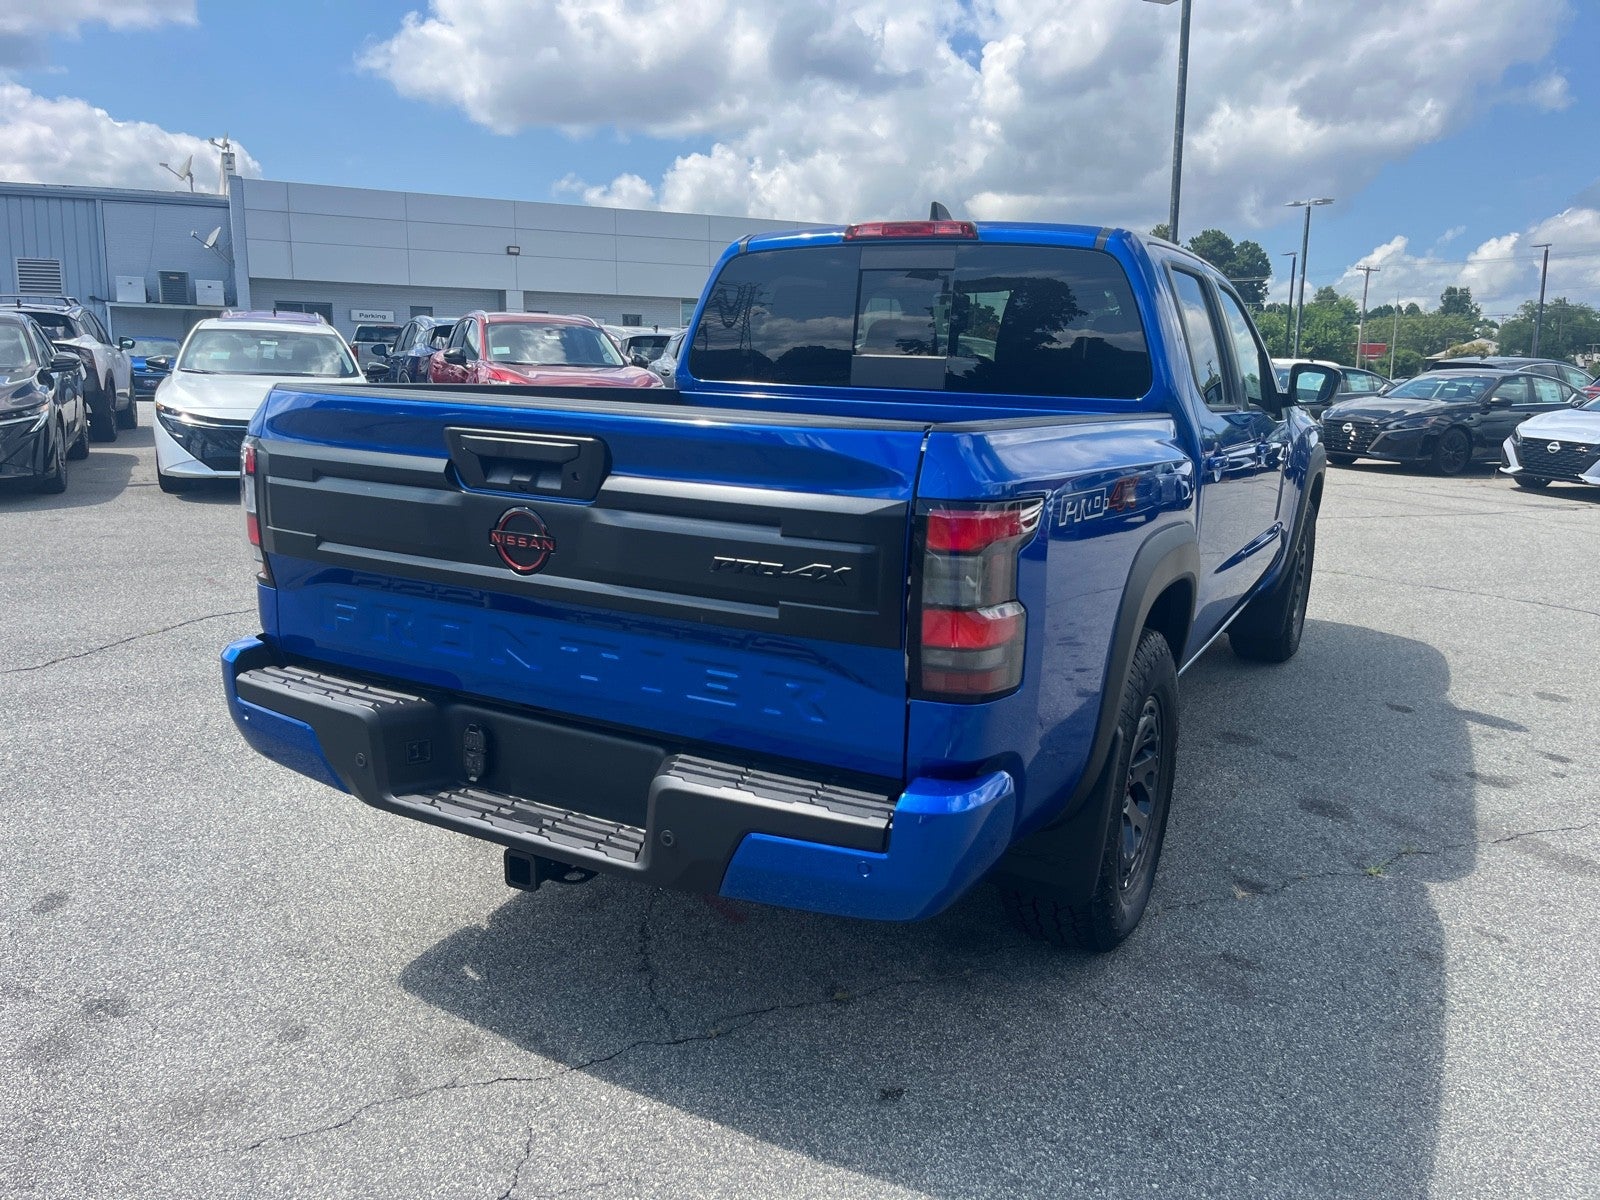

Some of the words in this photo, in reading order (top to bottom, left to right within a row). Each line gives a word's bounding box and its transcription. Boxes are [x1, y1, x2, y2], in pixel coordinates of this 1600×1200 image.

[359, 312, 387, 320] Parking
[491, 531, 555, 551] NISSAN
[321, 594, 827, 723] FRONTIER
